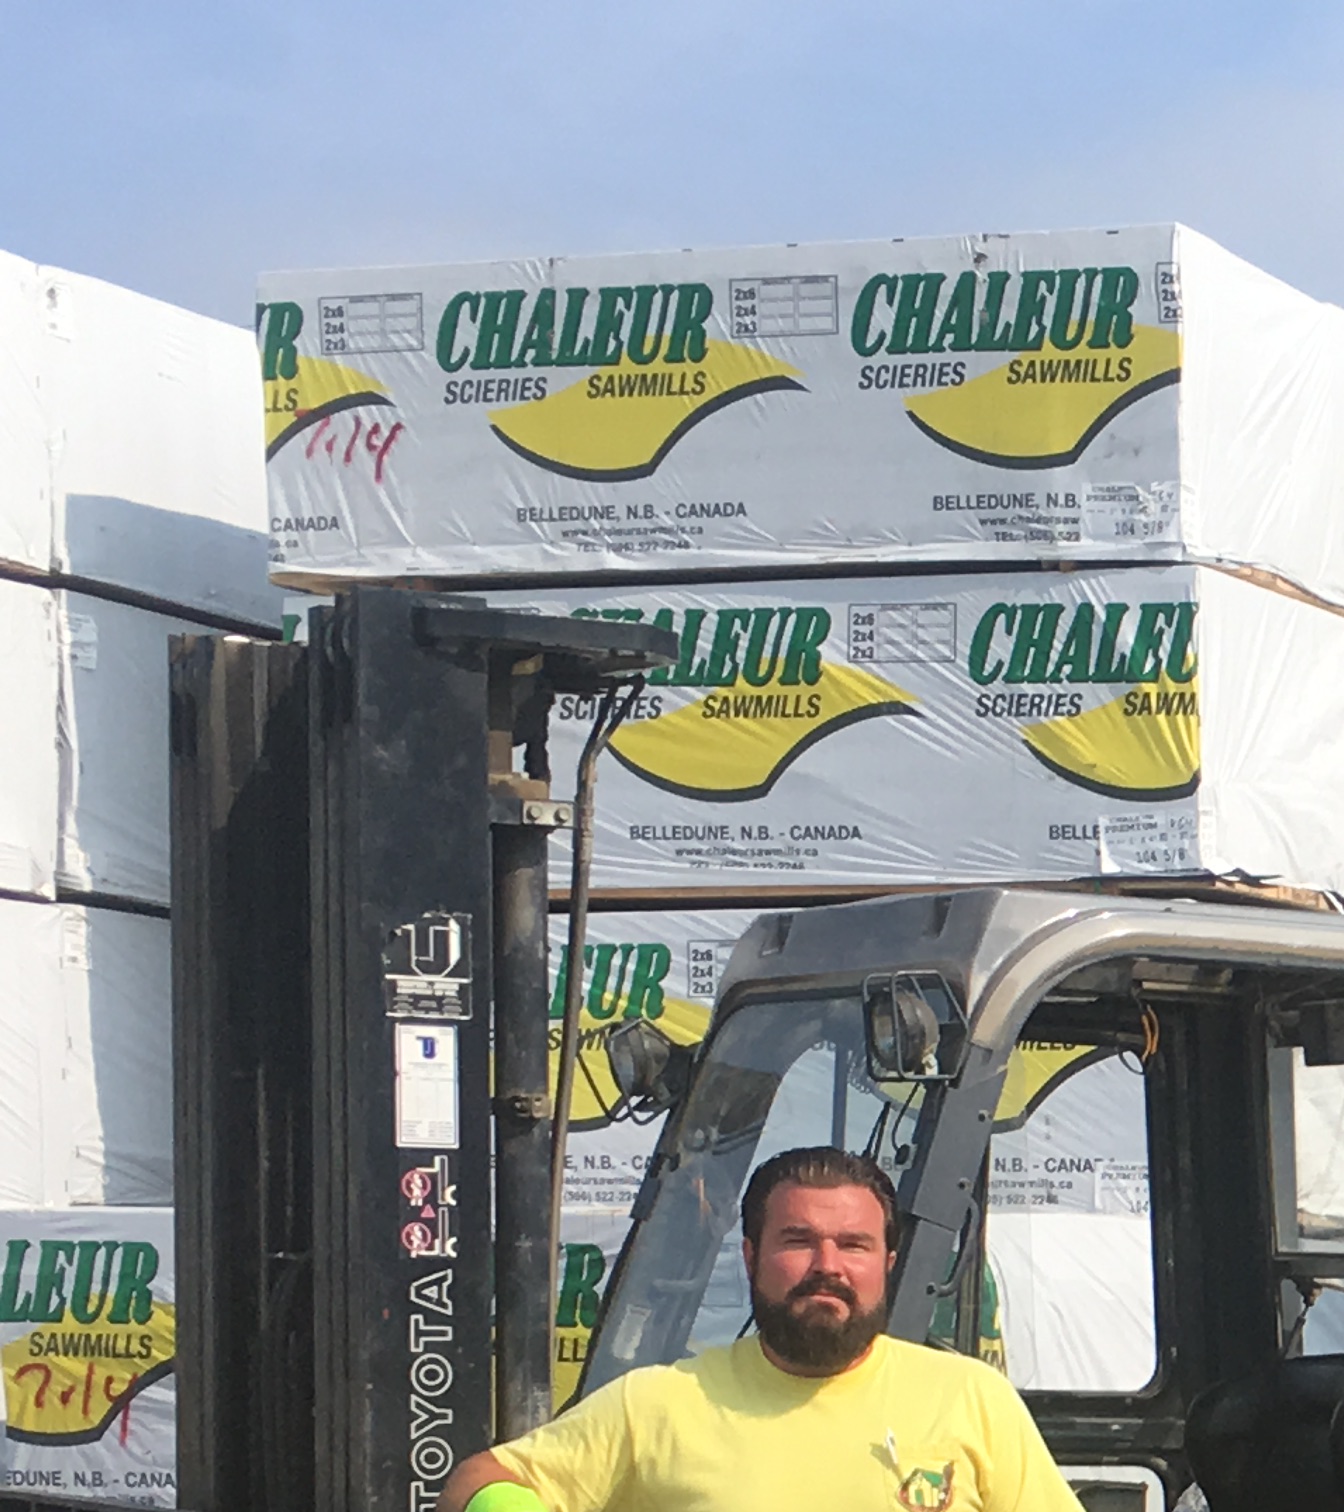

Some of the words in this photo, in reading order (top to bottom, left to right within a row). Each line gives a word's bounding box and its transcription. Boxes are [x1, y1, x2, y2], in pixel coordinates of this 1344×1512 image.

[734, 286, 757, 302] 2x6
[323, 304, 345, 319] 2x6
[735, 303, 757, 319] 2x4
[851, 266, 1140, 358] CHALEUR
[324, 321, 346, 335] 2x4
[435, 282, 715, 373] CHALEUR
[736, 321, 757, 337] 2x3
[324, 338, 346, 351] 2x3
[858, 361, 967, 390] SCIERIES
[1006, 356, 1133, 385] SAWMILLS
[443, 377, 548, 406] SCIERIES
[586, 371, 707, 400] SAWMILLS
[932, 492, 1040, 511] BELLEDUNE,
[1046, 492, 1082, 509] N.B.
[515, 505, 621, 523] BELLEDUNE,
[626, 503, 659, 520] N.B.
[674, 501, 748, 519] CANADA
[270, 515, 340, 532] CANADA
[852, 612, 875, 627] 2x6
[852, 629, 875, 644] 2x4
[570, 606, 832, 688] ALEUR
[852, 645, 875, 660] 2x3
[559, 695, 664, 720] SCIRES
[701, 694, 822, 719] SAWMILLS
[975, 693, 1083, 718] SCIERIES
[629, 825, 735, 841] BELLEDUNE,
[740, 825, 774, 841] N.B.
[790, 825, 863, 841] CANADA
[692, 949, 713, 962] 2x6
[692, 966, 713, 979] 2x4
[692, 982, 713, 995] 2x3
[994, 1157, 1029, 1173] N.B.
[1044, 1157, 1116, 1173] CANA
[29, 1331, 154, 1360] SAWMILLS
[73, 1470, 108, 1488] N.B.
